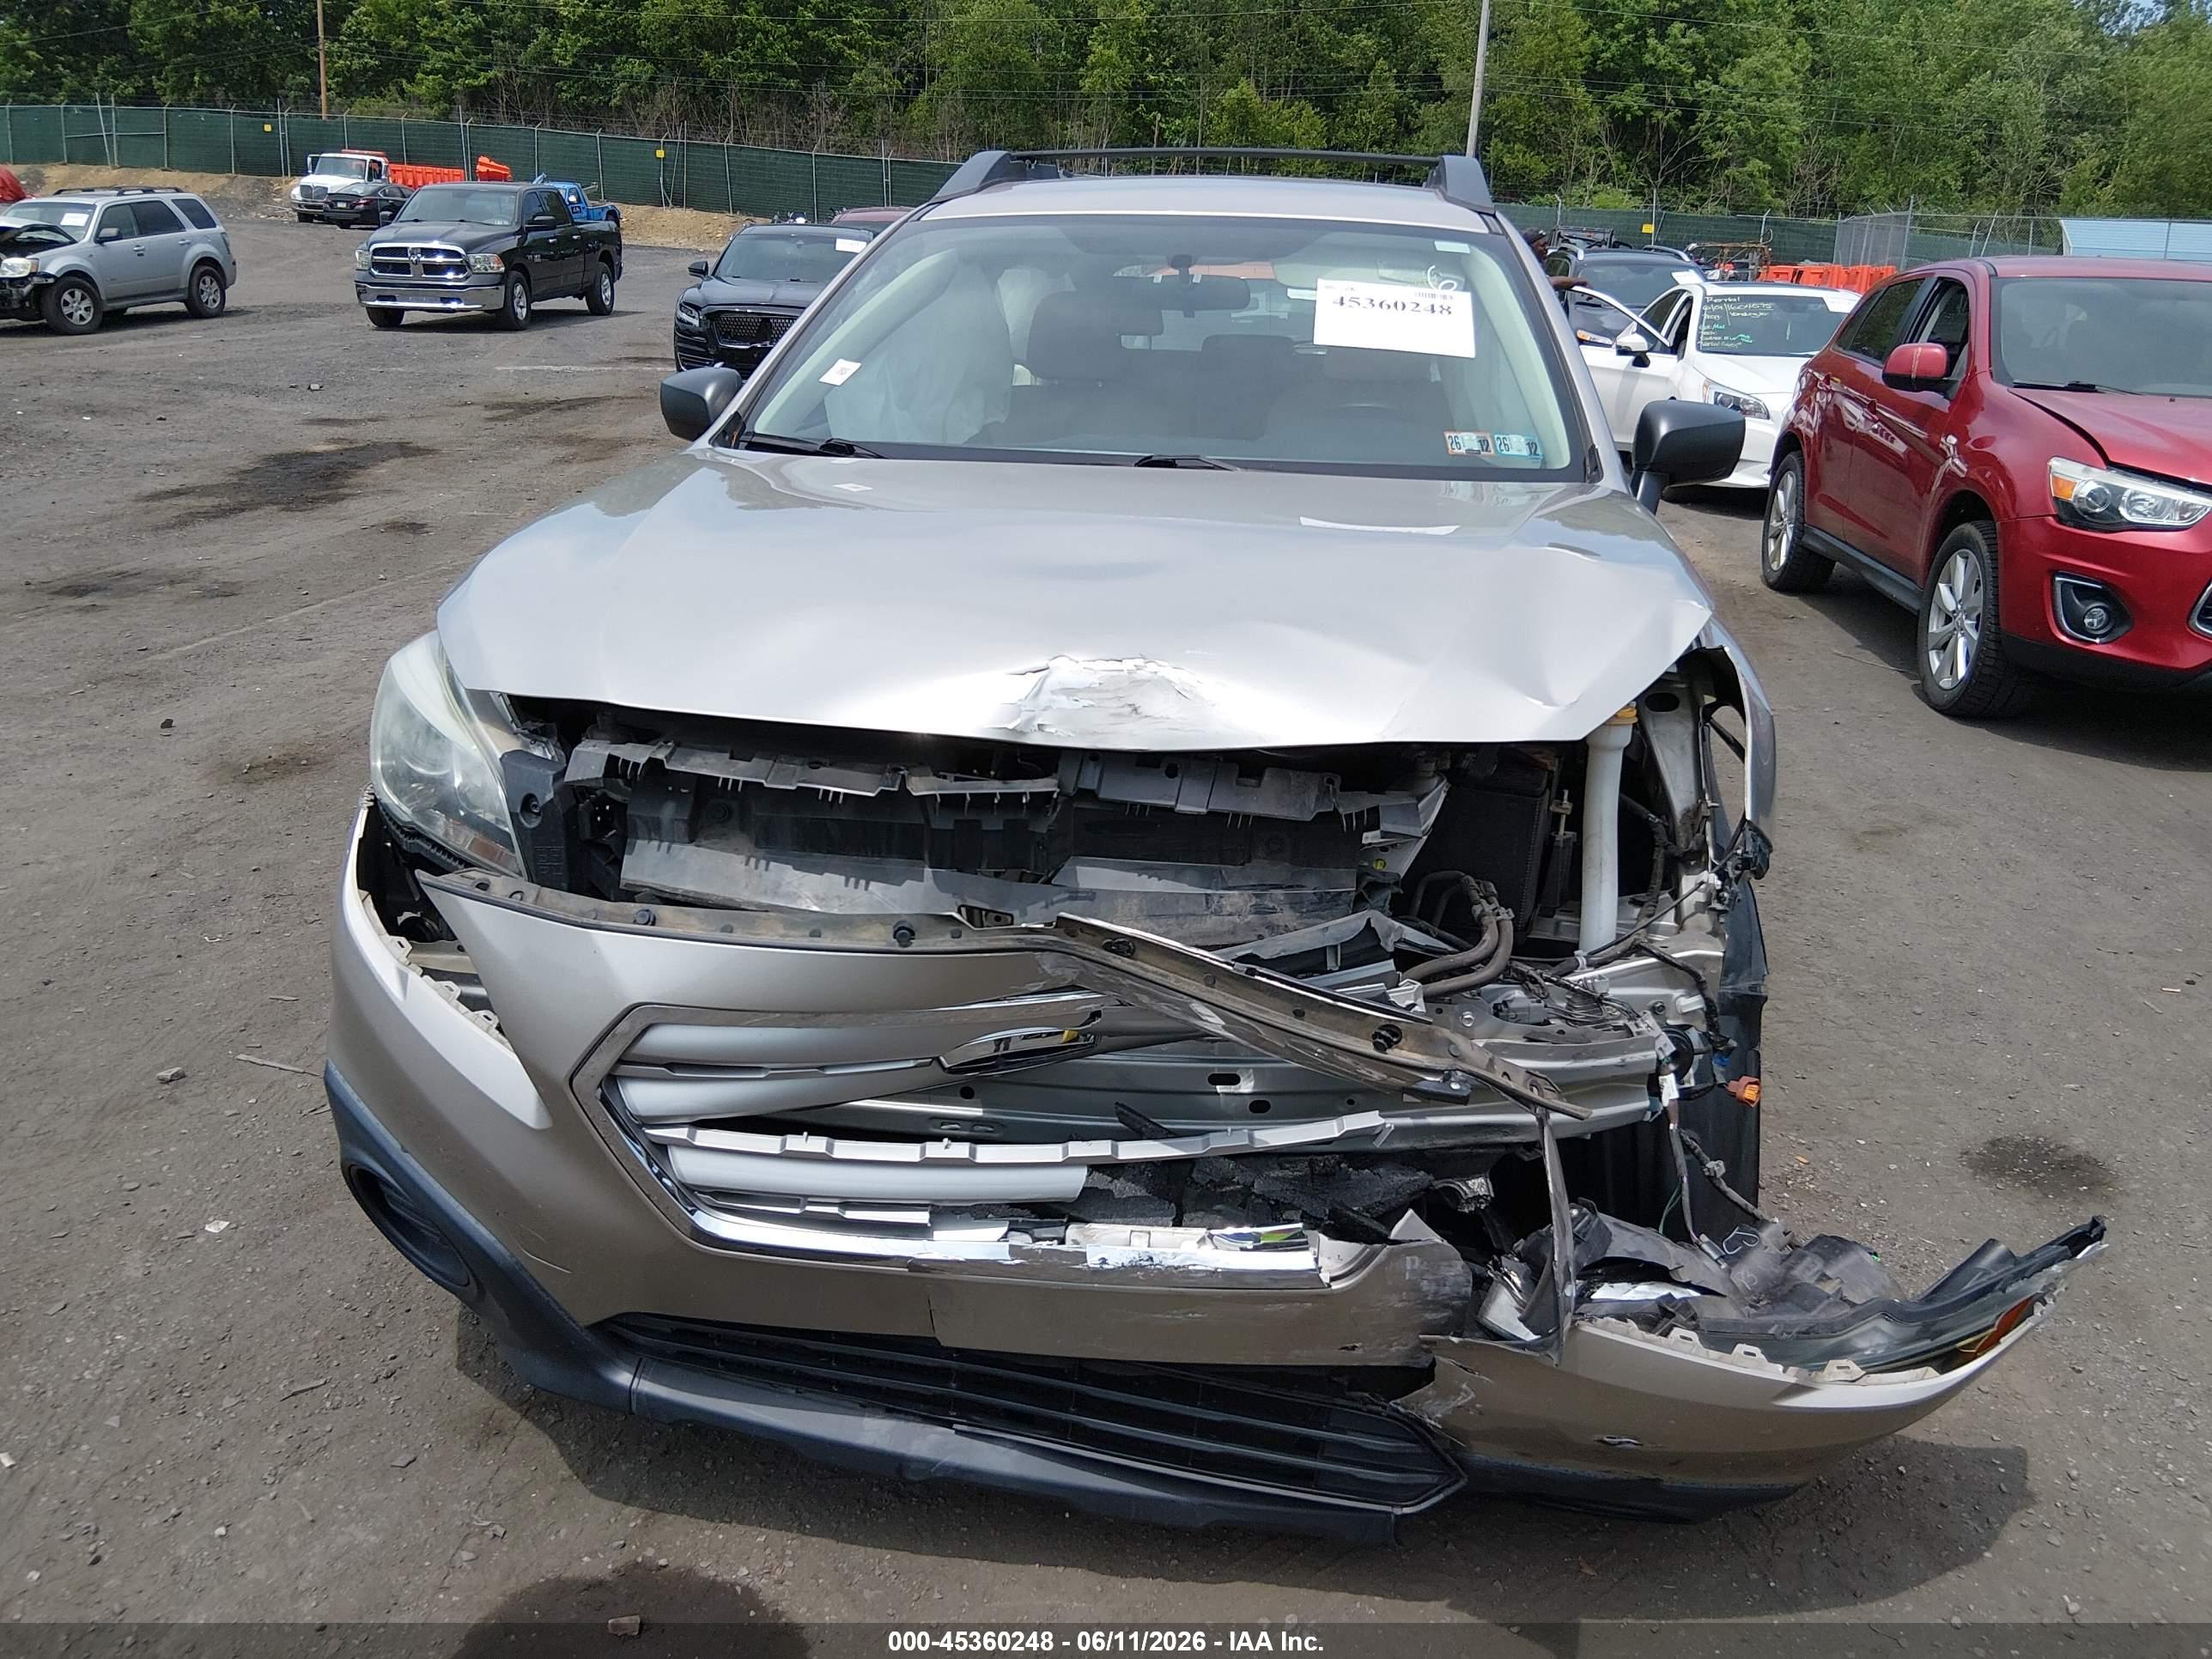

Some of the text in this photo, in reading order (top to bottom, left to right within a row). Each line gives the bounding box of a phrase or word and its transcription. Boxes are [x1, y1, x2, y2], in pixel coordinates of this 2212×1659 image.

[1332, 295, 1453, 315] 45360248
[1448, 434, 1462, 451] 26
[1477, 439, 1492, 453] 12
[1496, 436, 1510, 453] 26
[1526, 441, 1540, 457] 12
